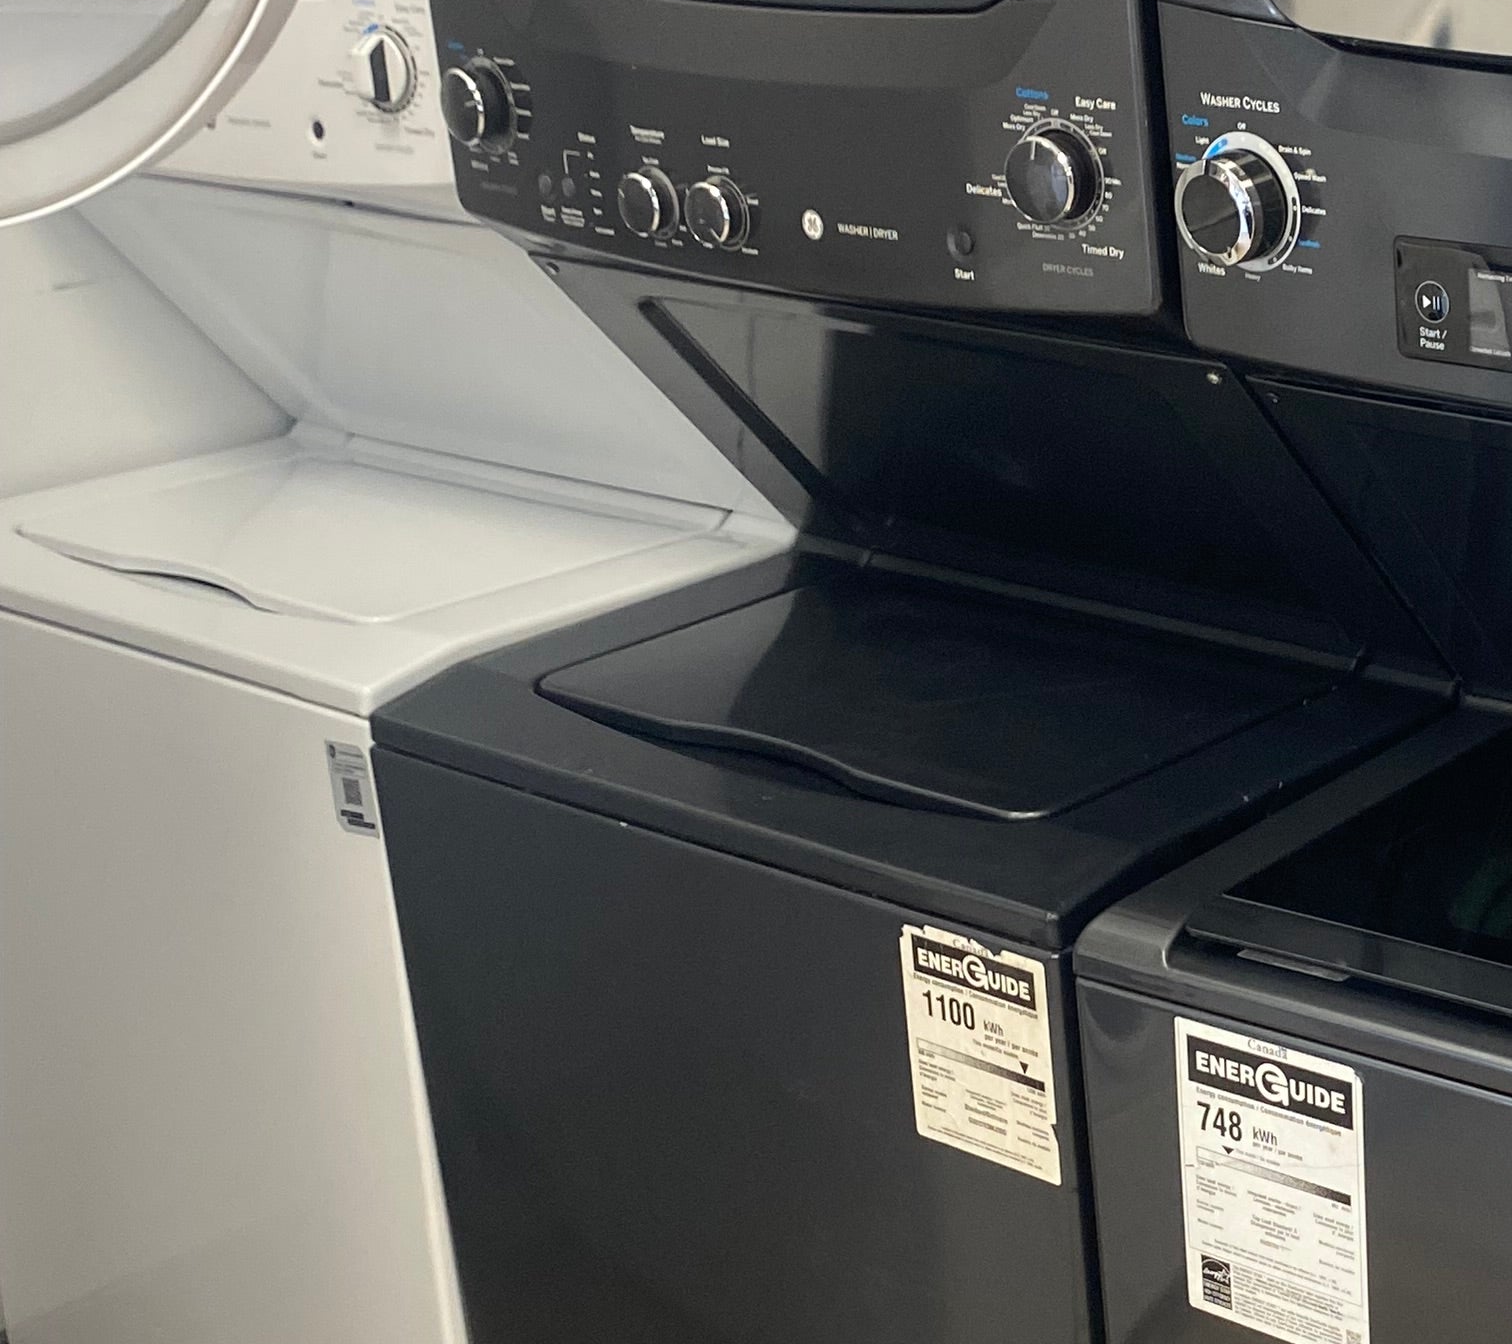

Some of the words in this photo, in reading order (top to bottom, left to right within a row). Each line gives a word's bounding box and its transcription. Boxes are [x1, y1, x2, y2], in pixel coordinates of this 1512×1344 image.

[1075, 96, 1095, 110] Easy
[1096, 98, 1116, 111] Care
[1200, 91, 1241, 109] WASHER
[1242, 95, 1280, 114] CYCLES
[966, 183, 1003, 197] Delicates
[1082, 244, 1107, 256] Timed
[1109, 246, 1124, 260] Dry
[954, 268, 975, 281] Start
[1197, 262, 1226, 277] Whites
[1419, 326, 1441, 339] Start
[1420, 338, 1445, 351] Pause
[917, 947, 1031, 1002] ENERGUIDE
[922, 989, 976, 1031] 1100
[983, 1019, 1004, 1037] kWh
[1247, 1038, 1288, 1060] Canada
[1195, 1050, 1346, 1115] ENERGUIDE
[1196, 1100, 1243, 1142] 748
[1252, 1126, 1278, 1146] kWh
